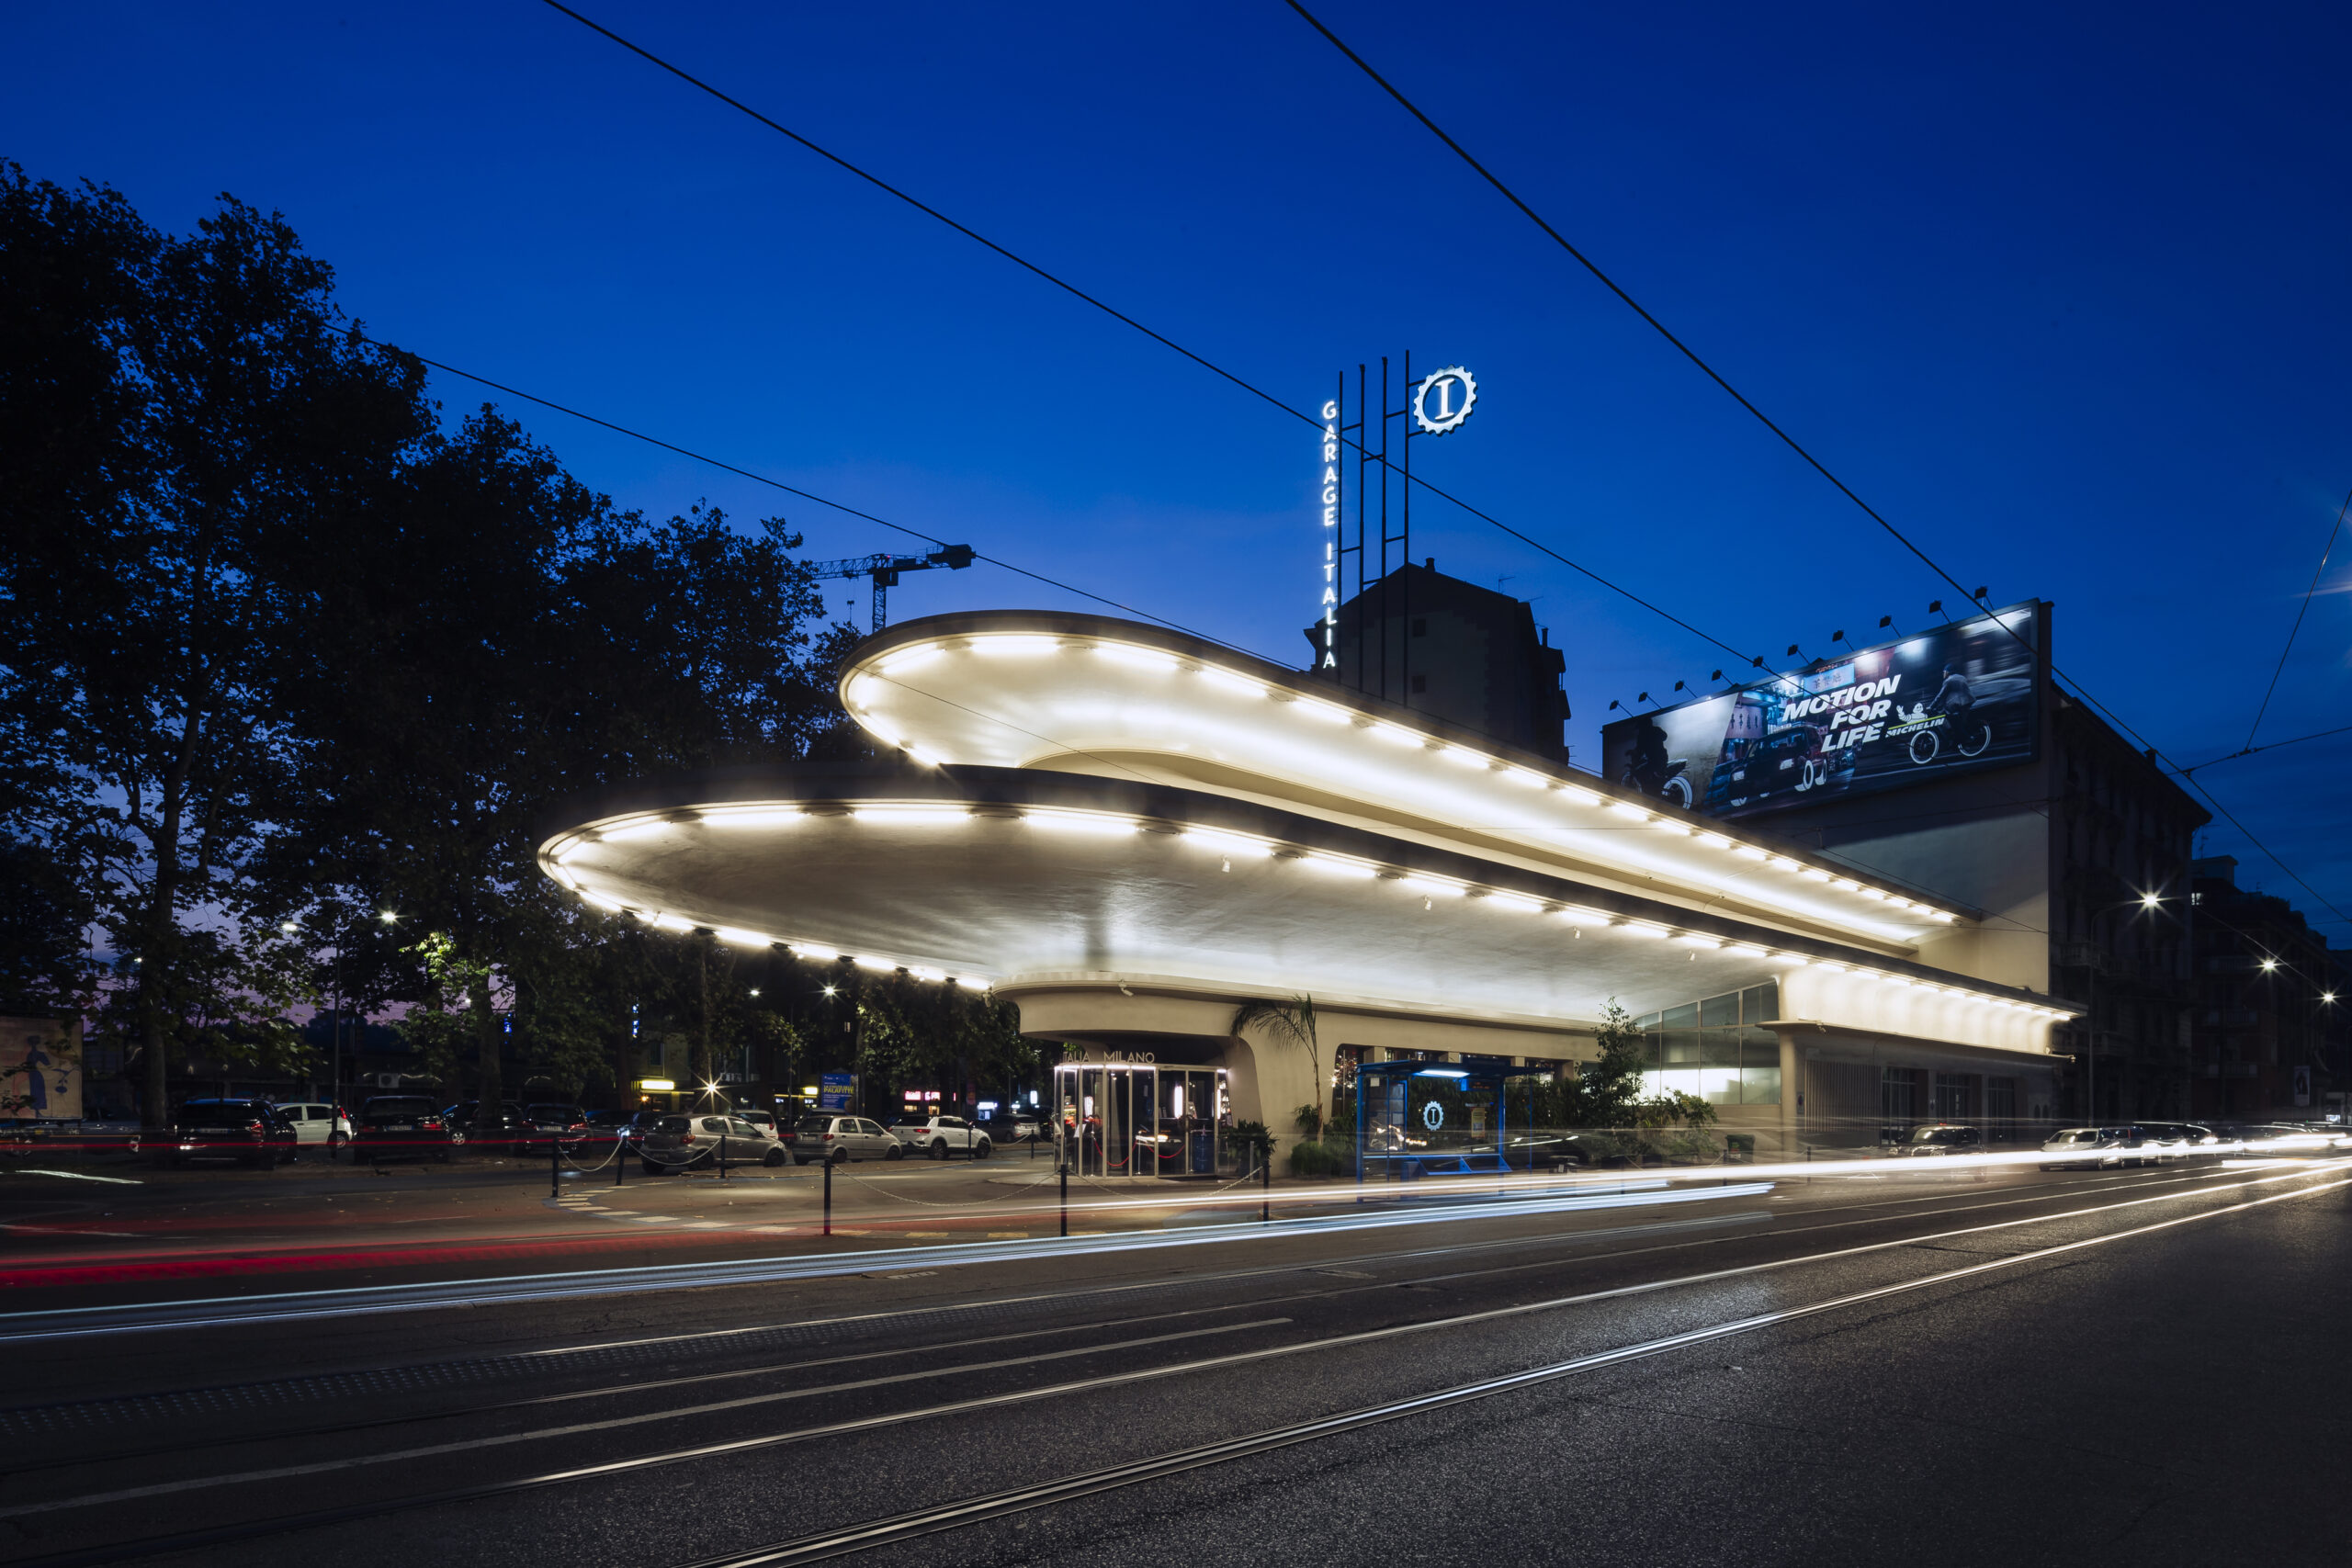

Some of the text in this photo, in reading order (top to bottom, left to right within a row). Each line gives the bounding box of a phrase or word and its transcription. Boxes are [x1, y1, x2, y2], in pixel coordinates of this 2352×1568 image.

[1322, 400, 1338, 669] GARAGE ITALIA
[1781, 673, 1902, 722] MOTION
[1829, 699, 1892, 730] FOR
[1884, 717, 1945, 739] MICHELIN
[1820, 721, 1885, 753] LIFE
[1103, 1050, 1155, 1064] MILANO
